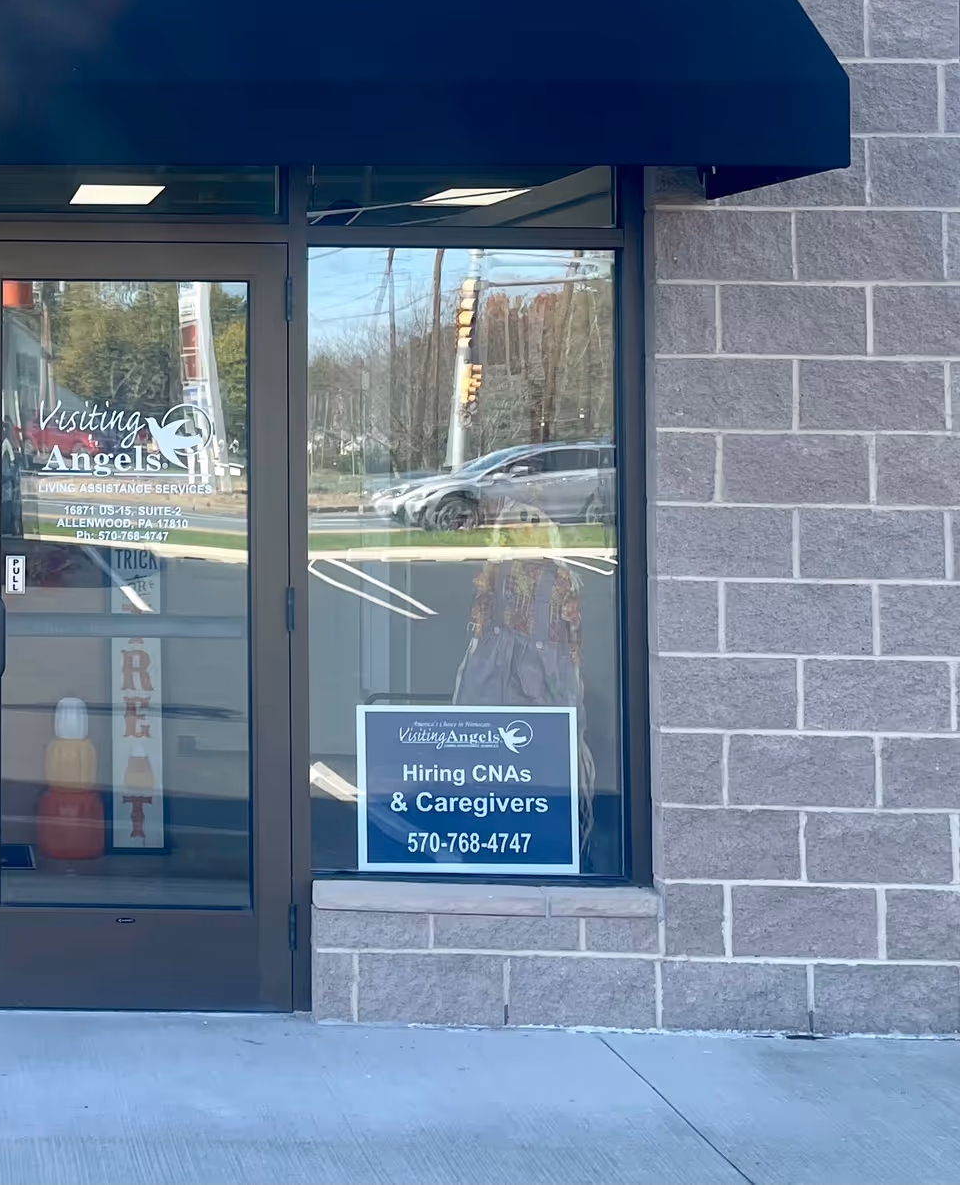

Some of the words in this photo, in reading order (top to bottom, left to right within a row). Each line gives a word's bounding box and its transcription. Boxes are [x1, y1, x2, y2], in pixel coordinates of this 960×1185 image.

[40, 399, 146, 449] Visiting
[38, 483, 75, 493] LIVING
[79, 483, 151, 494] ASSISTANCE
[155, 484, 212, 494] SERVICES
[63, 505, 94, 516] 16871
[99, 505, 134, 517] US-15,
[138, 506, 182, 517] SUITE-2
[56, 518, 134, 530] ALLENWOOD,
[138, 519, 153, 529] PA
[157, 519, 189, 529] 17810
[76, 530, 94, 540] Ph:
[98, 531, 169, 541] 570-768-4747
[12, 558, 20, 591] PULL
[399, 726, 447, 749] Visiting
[447, 729, 500, 745] Angels
[403, 764, 466, 786] Hiring
[472, 764, 532, 782] CNAs
[390, 791, 408, 813] &
[416, 791, 549, 817] Caregivers
[407, 832, 532, 853] 570-768-4747
